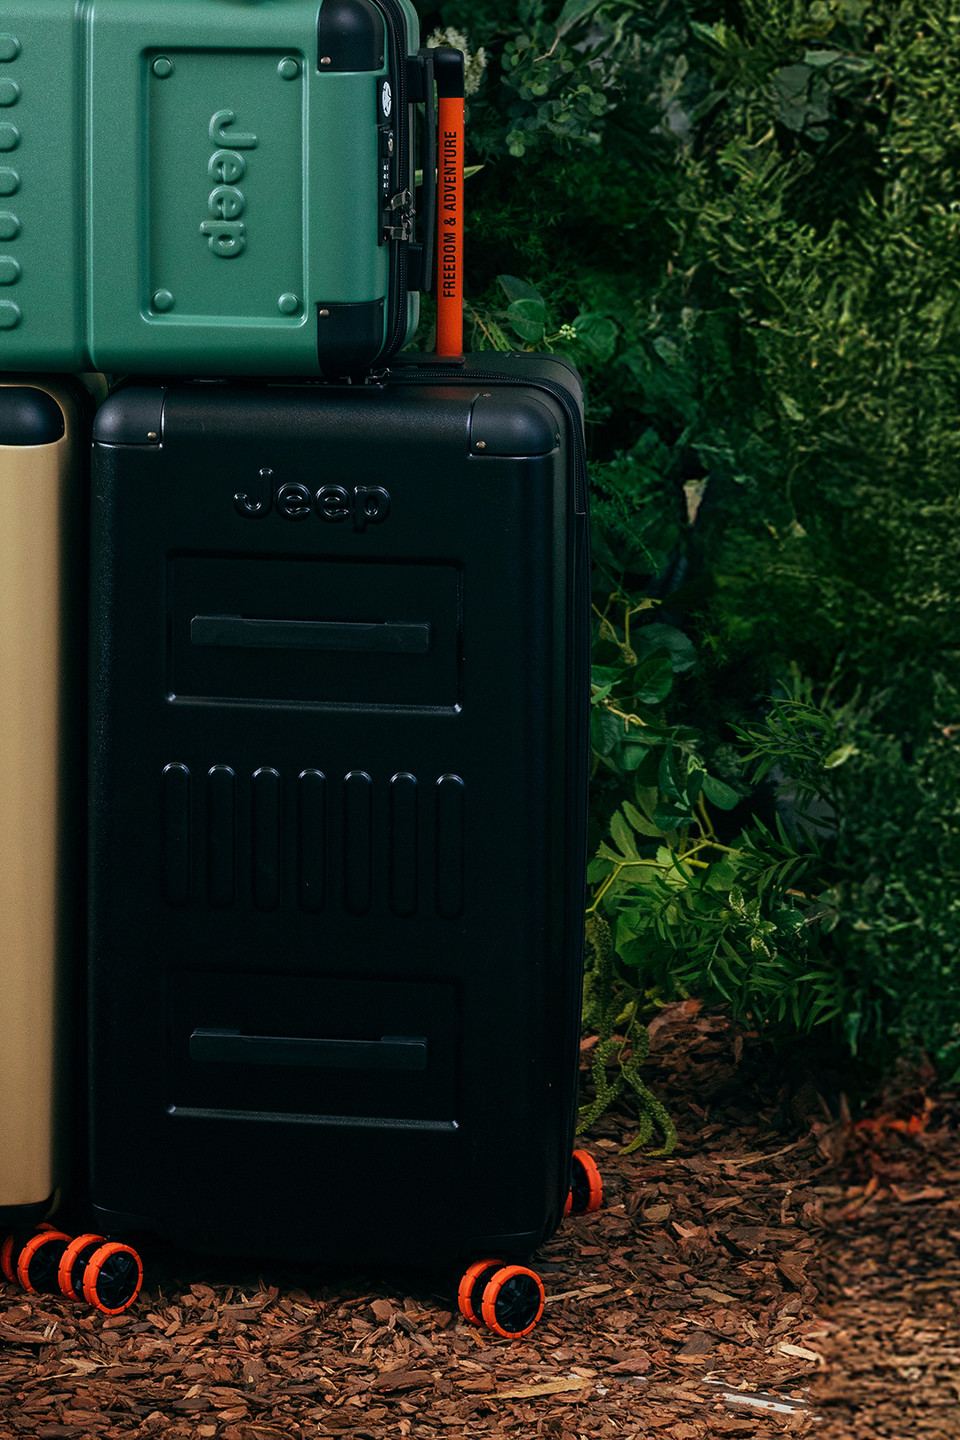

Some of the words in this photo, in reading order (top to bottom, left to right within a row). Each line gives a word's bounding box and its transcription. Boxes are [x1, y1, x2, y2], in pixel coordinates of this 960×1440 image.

[199, 109, 258, 258] Jeep
[443, 131, 457, 212] ADVENTURE
[443, 217, 456, 227] &
[443, 232, 456, 298] FREEDOM
[234, 467, 390, 533] Jeep
